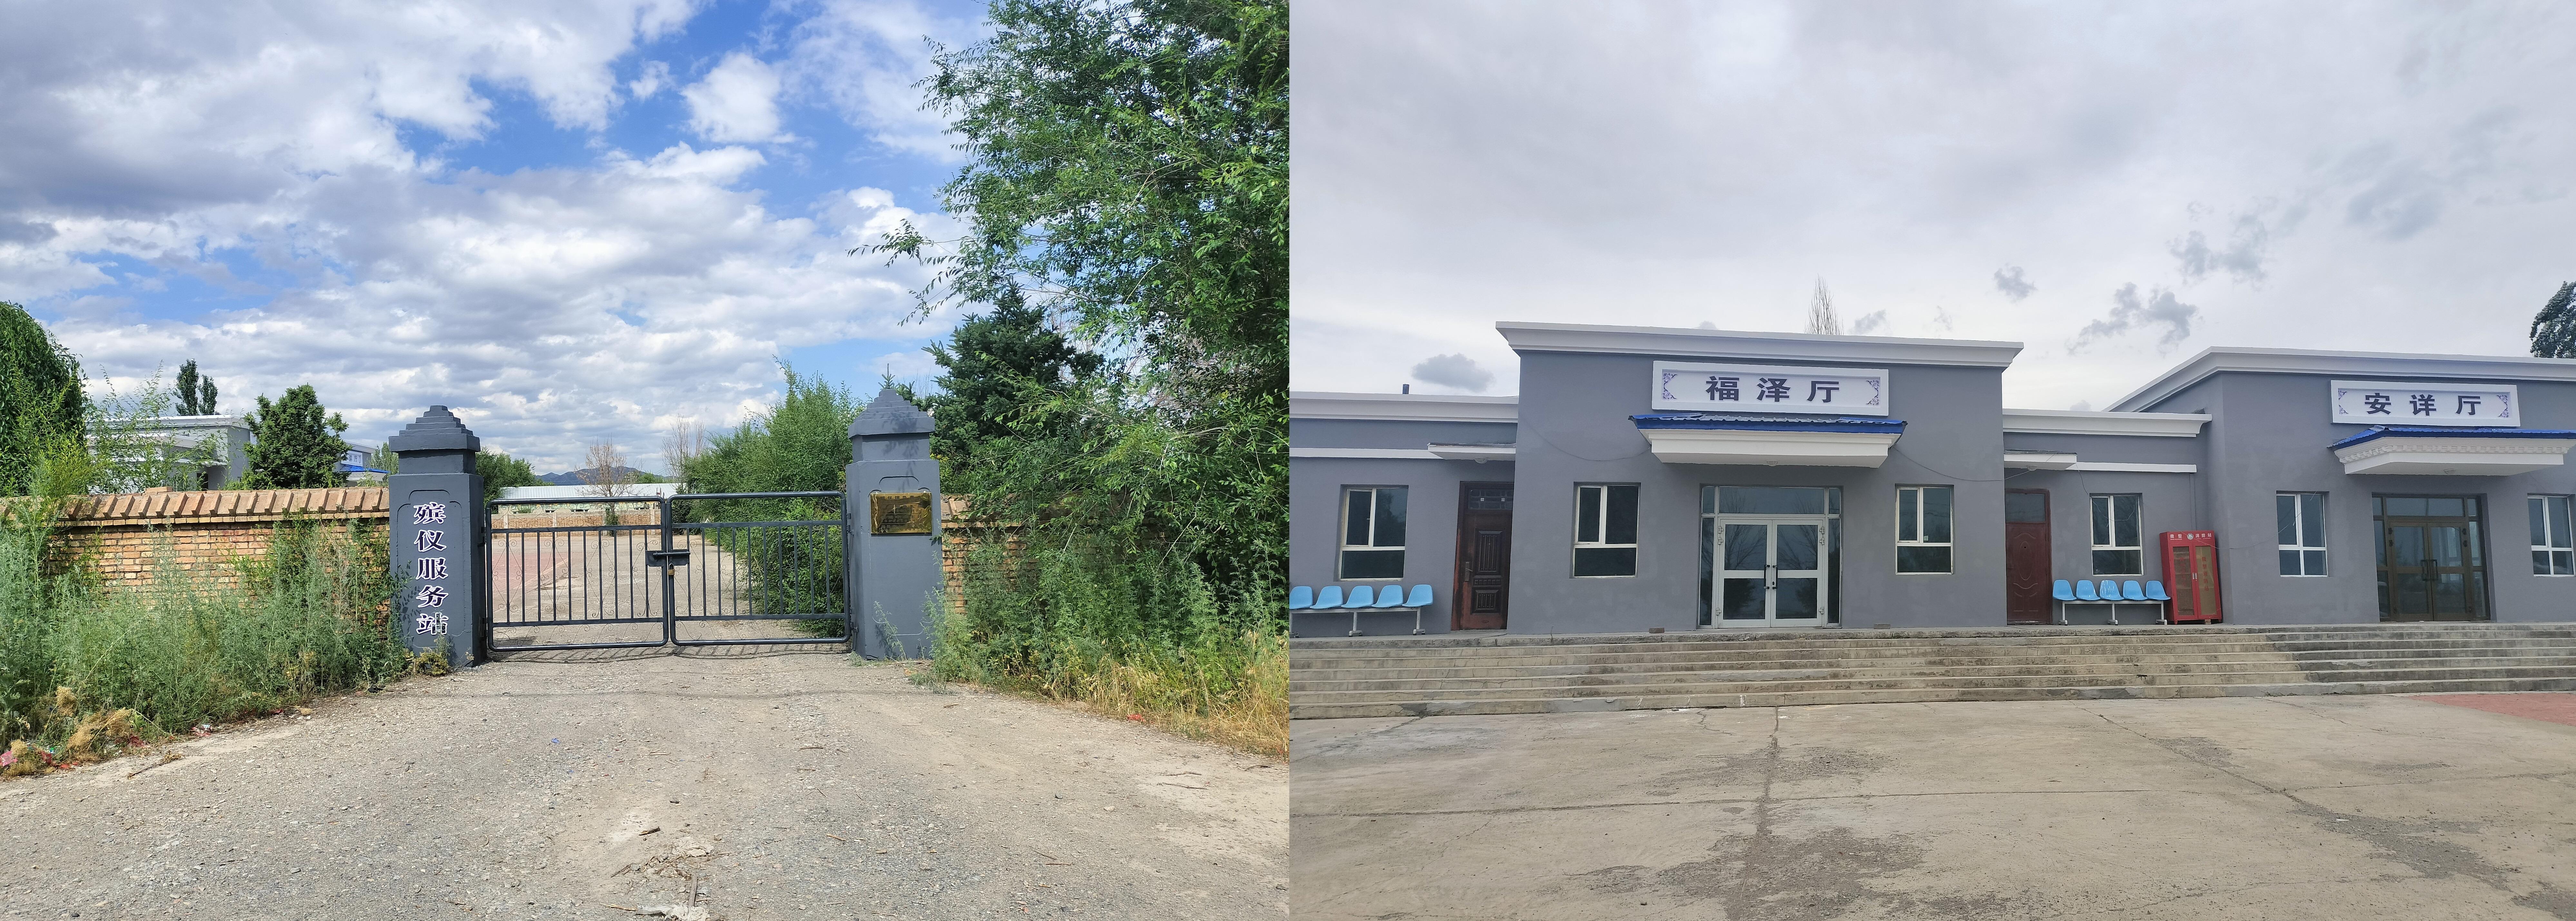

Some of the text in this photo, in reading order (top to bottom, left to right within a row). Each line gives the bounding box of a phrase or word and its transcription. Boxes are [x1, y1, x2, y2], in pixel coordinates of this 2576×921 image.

[1705, 376, 1839, 403] 福泽厅
[2364, 392, 2481, 416] 安详厅
[414, 502, 449, 635] 殡仪服务站
